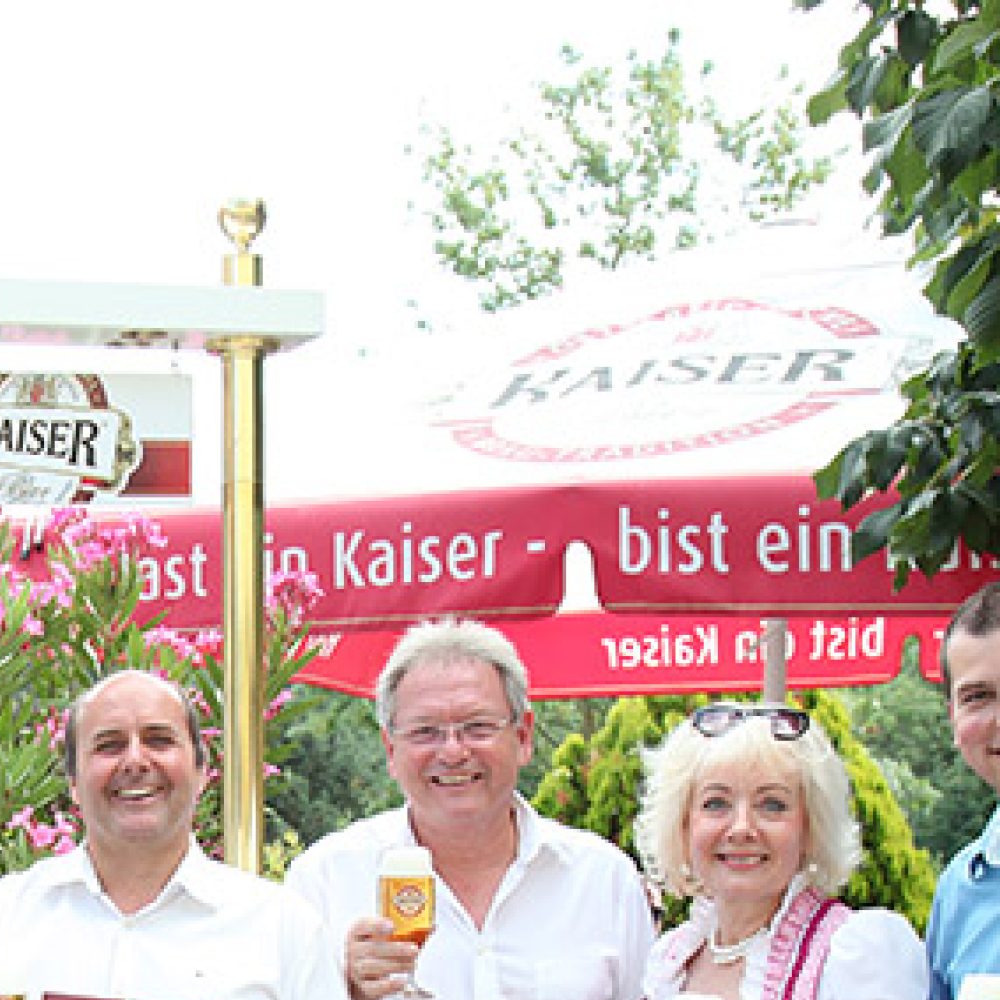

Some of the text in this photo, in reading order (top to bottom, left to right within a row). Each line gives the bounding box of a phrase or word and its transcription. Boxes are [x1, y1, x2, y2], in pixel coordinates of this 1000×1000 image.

[489, 347, 858, 409] KAISER
[122, 542, 209, 601] ast
[333, 520, 504, 590] Kaiser
[618, 504, 731, 576] bist
[755, 504, 854, 574] ein
